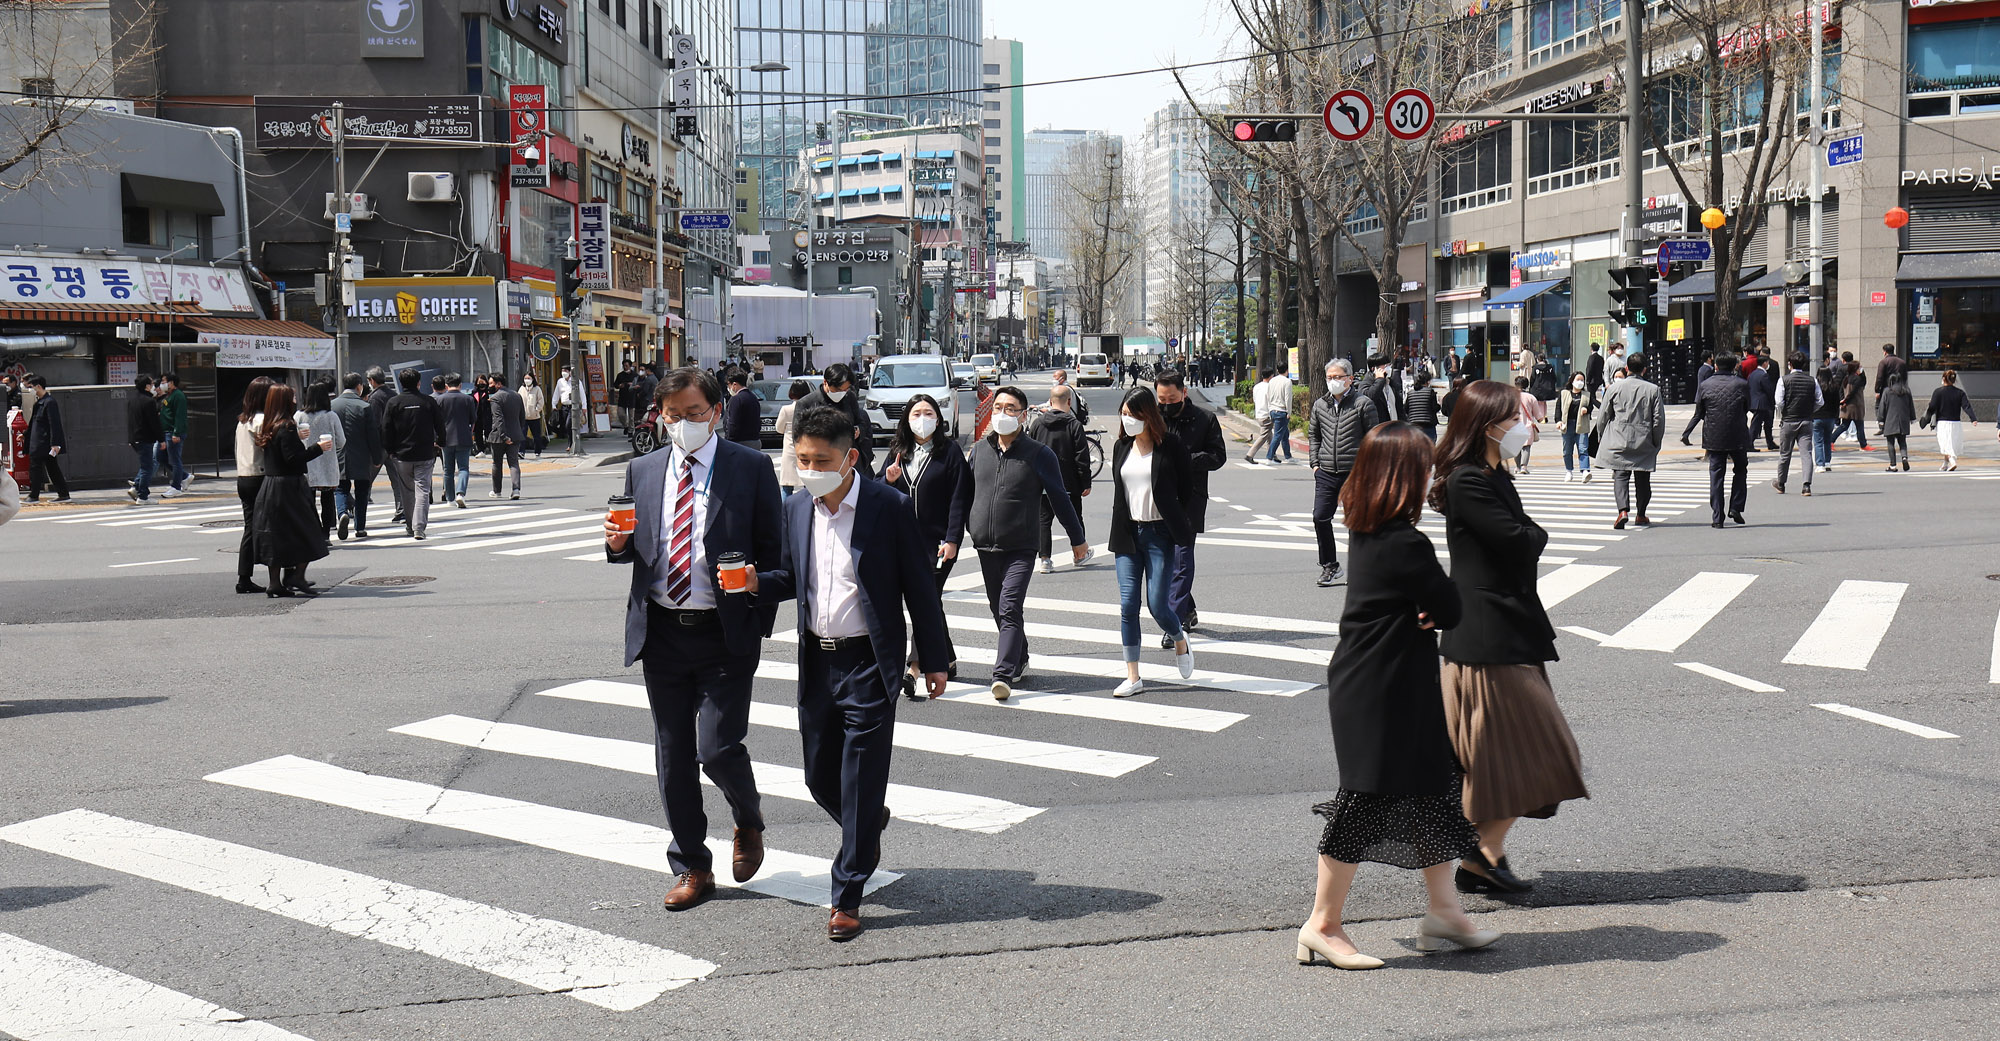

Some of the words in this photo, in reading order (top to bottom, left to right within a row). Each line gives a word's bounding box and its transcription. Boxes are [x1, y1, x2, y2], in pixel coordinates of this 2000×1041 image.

[1532, 90, 1559, 113] TREE
[1559, 82, 1584, 106] SKIN
[1396, 101, 1424, 129] 30
[429, 126, 469, 136] 737-8592
[919, 168, 956, 180] 고시원
[1901, 167, 1974, 186] PARIS
[692, 215, 718, 223] 우정국로
[581, 206, 606, 270] 백부장집
[813, 231, 865, 246] 깡장집
[866, 250, 889, 262] 안경
[1516, 250, 1555, 270] MINISTOP
[6, 264, 133, 299] 공평동
[581, 271, 608, 281] 닭1마리
[420, 297, 479, 316] COFFEE
[1636, 309, 1647, 325] 16
[1589, 325, 1604, 338] 임대
[398, 335, 452, 346] 신장개업
